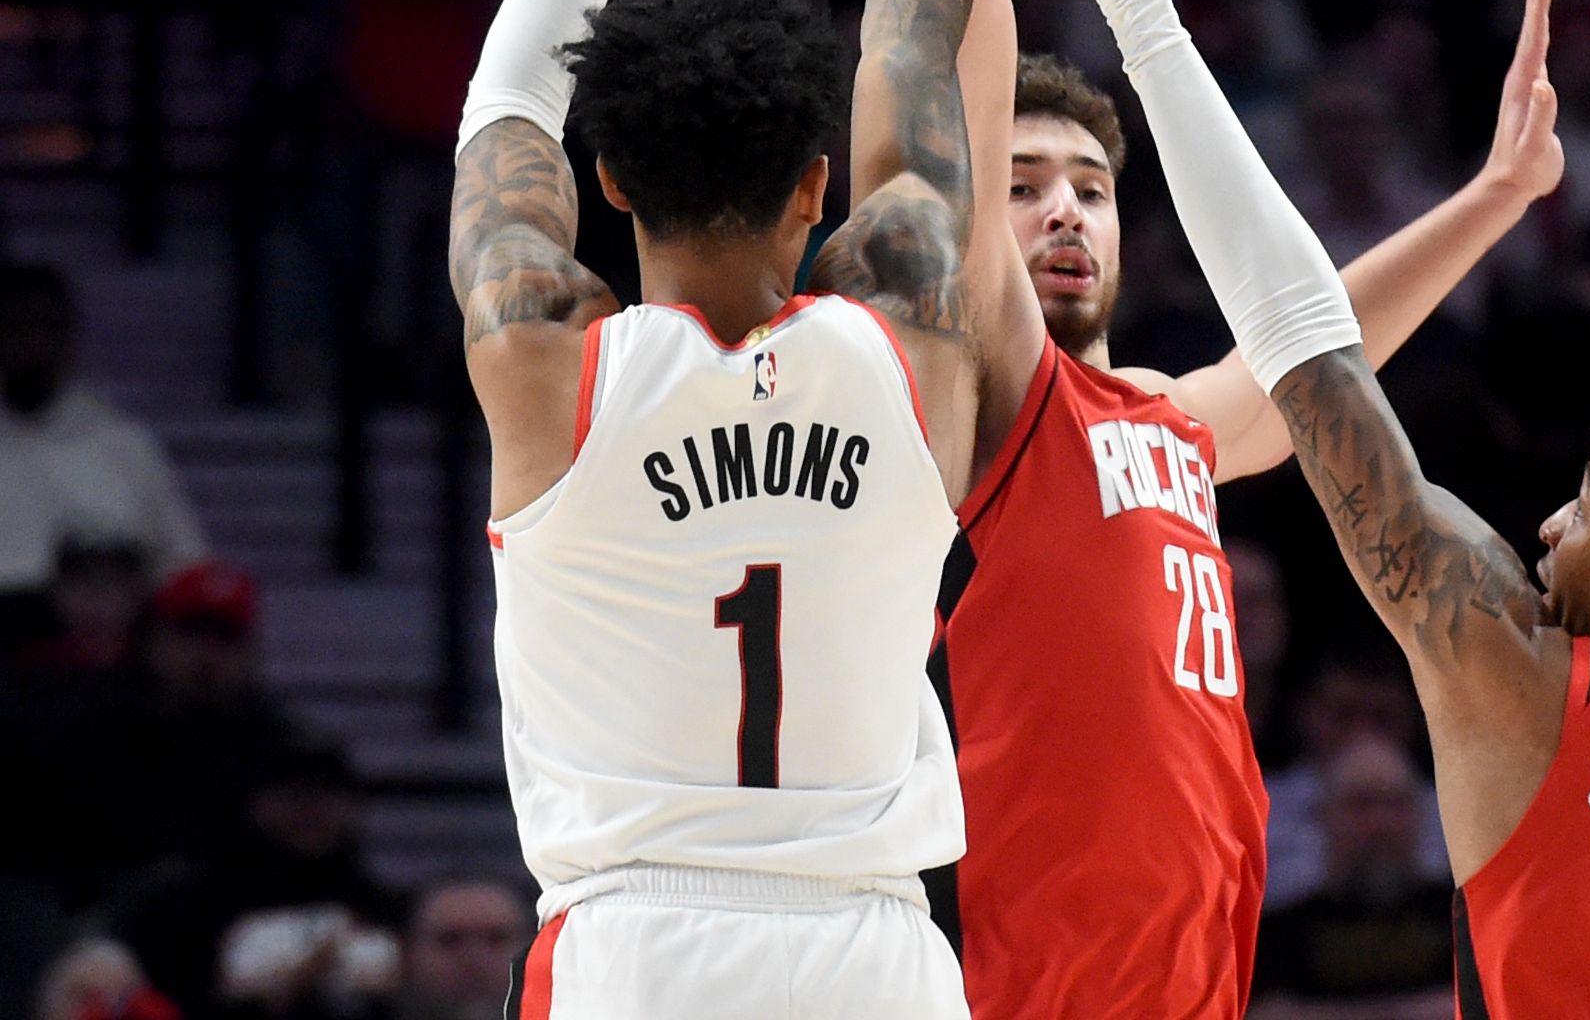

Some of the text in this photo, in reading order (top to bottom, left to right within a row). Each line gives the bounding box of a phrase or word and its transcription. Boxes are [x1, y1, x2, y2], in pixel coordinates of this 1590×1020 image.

[643, 421, 870, 522] SIMONS
[714, 563, 783, 789] 1
[1163, 544, 1238, 697] 28
